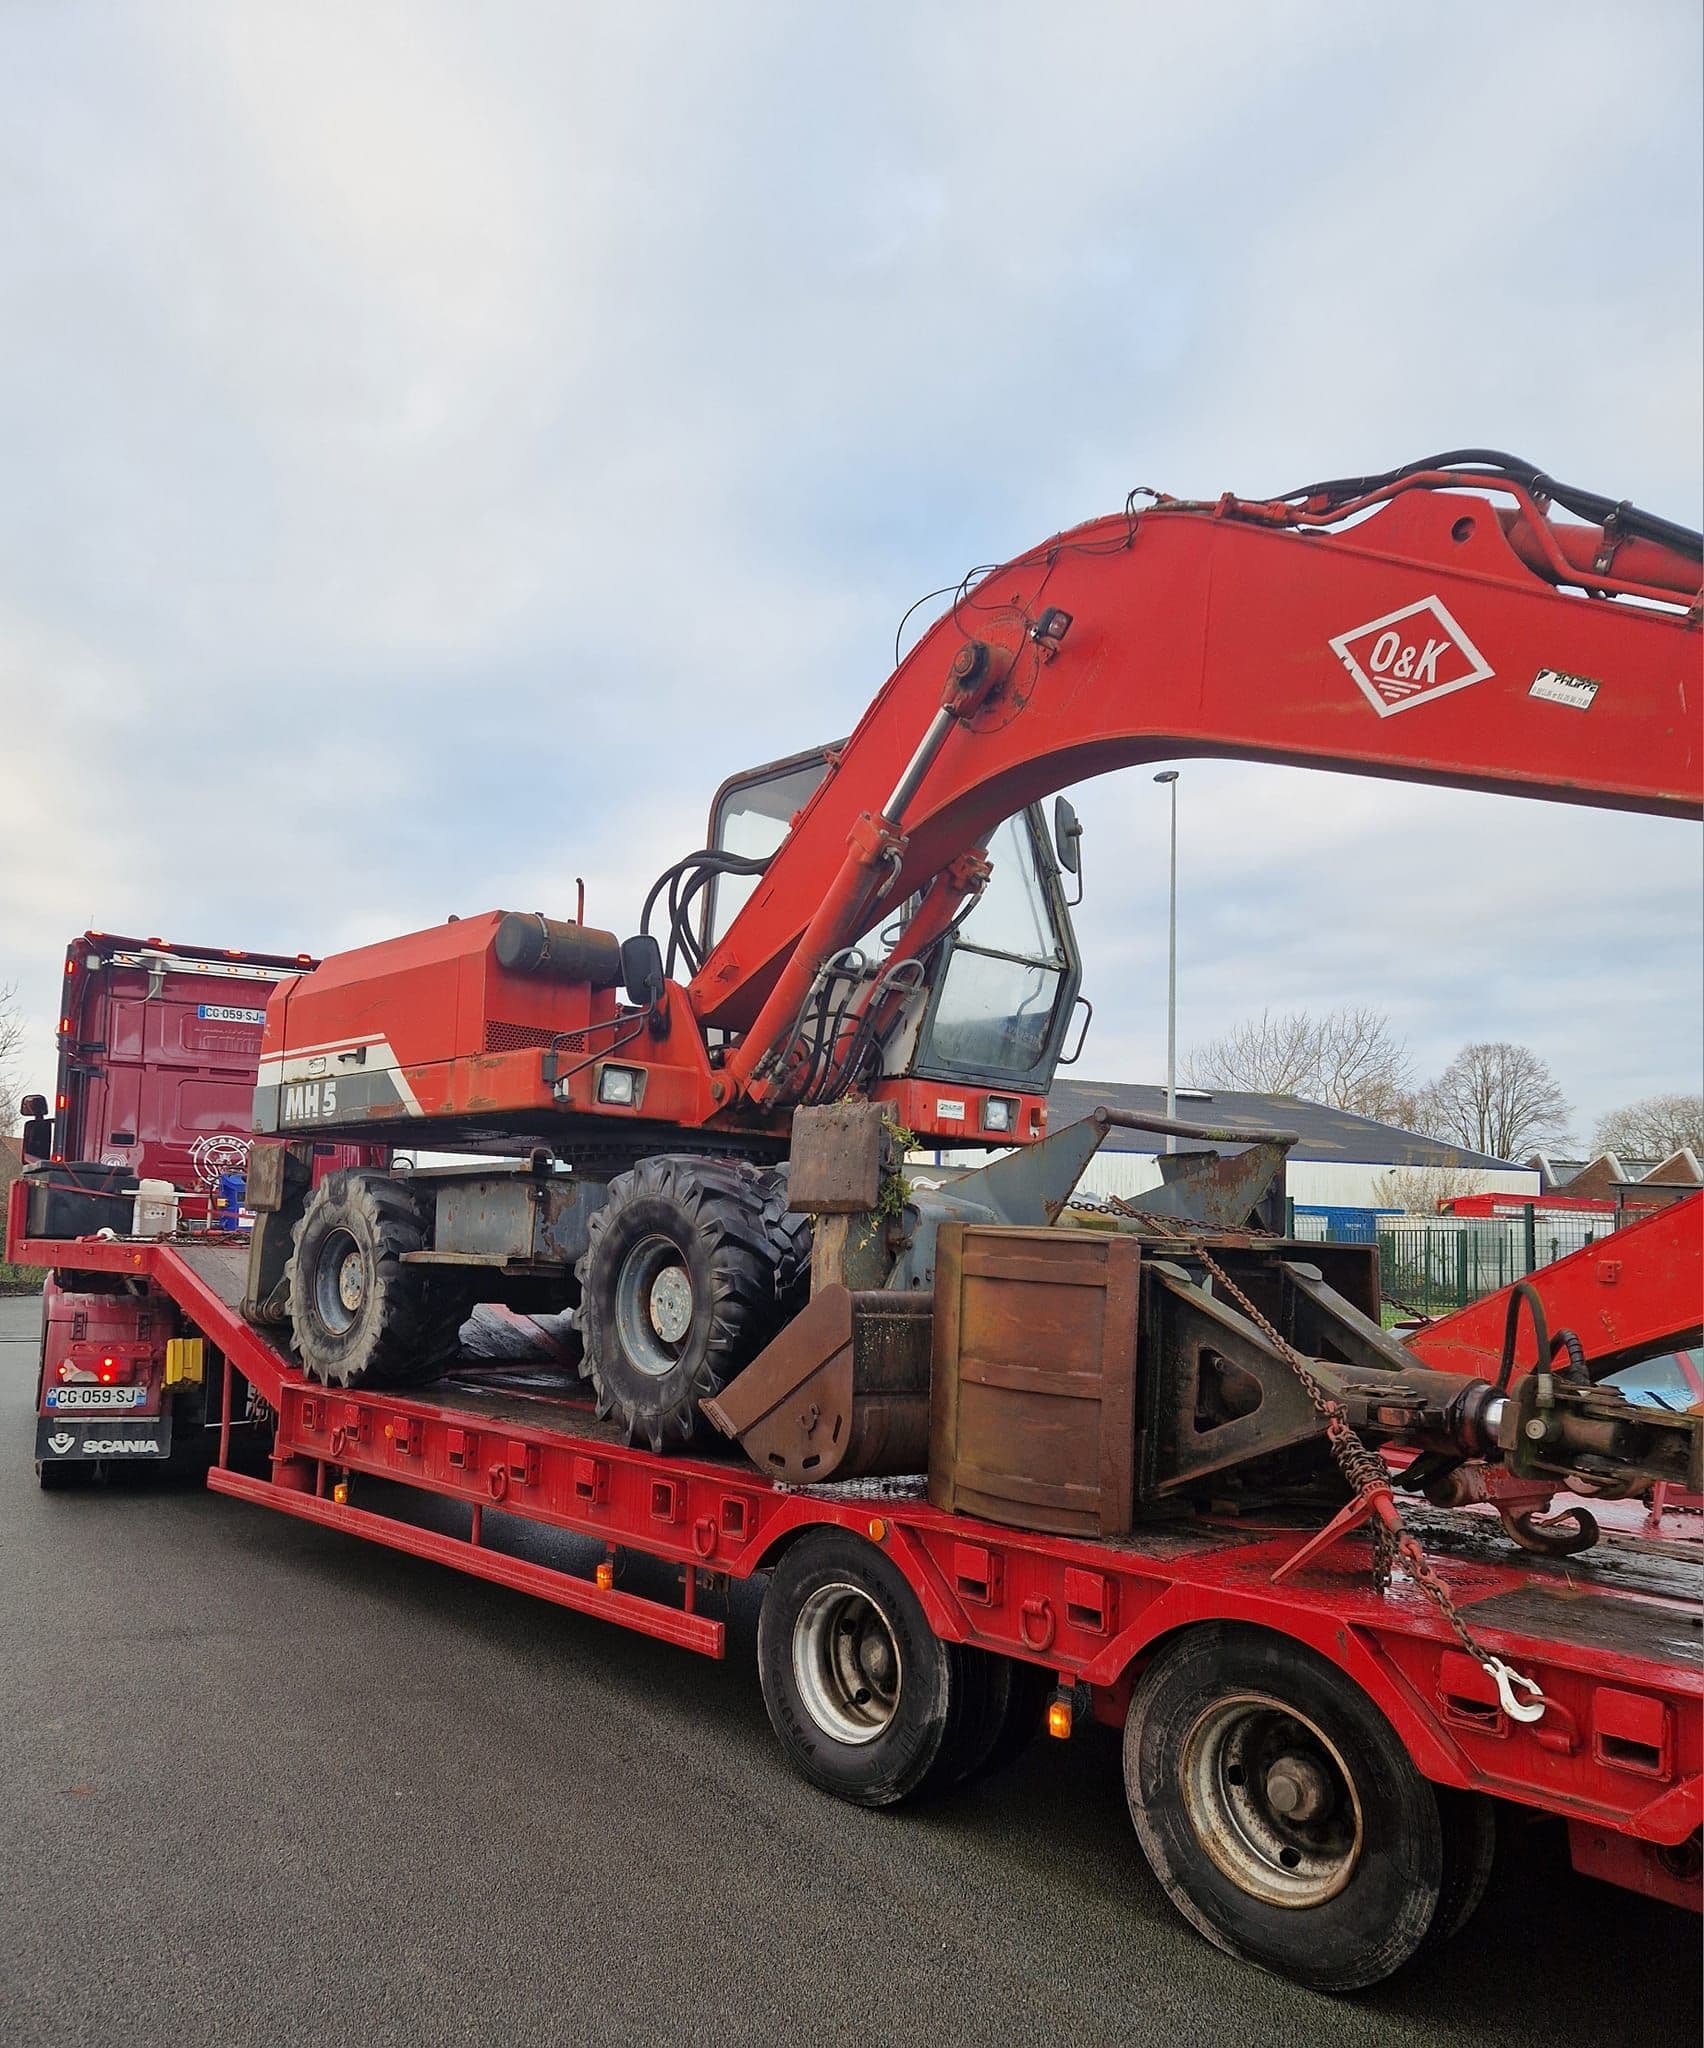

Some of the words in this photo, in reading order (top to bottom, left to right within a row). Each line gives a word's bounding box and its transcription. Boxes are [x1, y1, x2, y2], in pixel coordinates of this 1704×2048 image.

[1369, 631, 1451, 683] O&K
[206, 1007, 259, 1021] CG-059-SJ
[203, 1138, 248, 1154] SCANIA
[57, 1389, 136, 1404] CG-059-SJ
[82, 1439, 160, 1454] SCANIA
